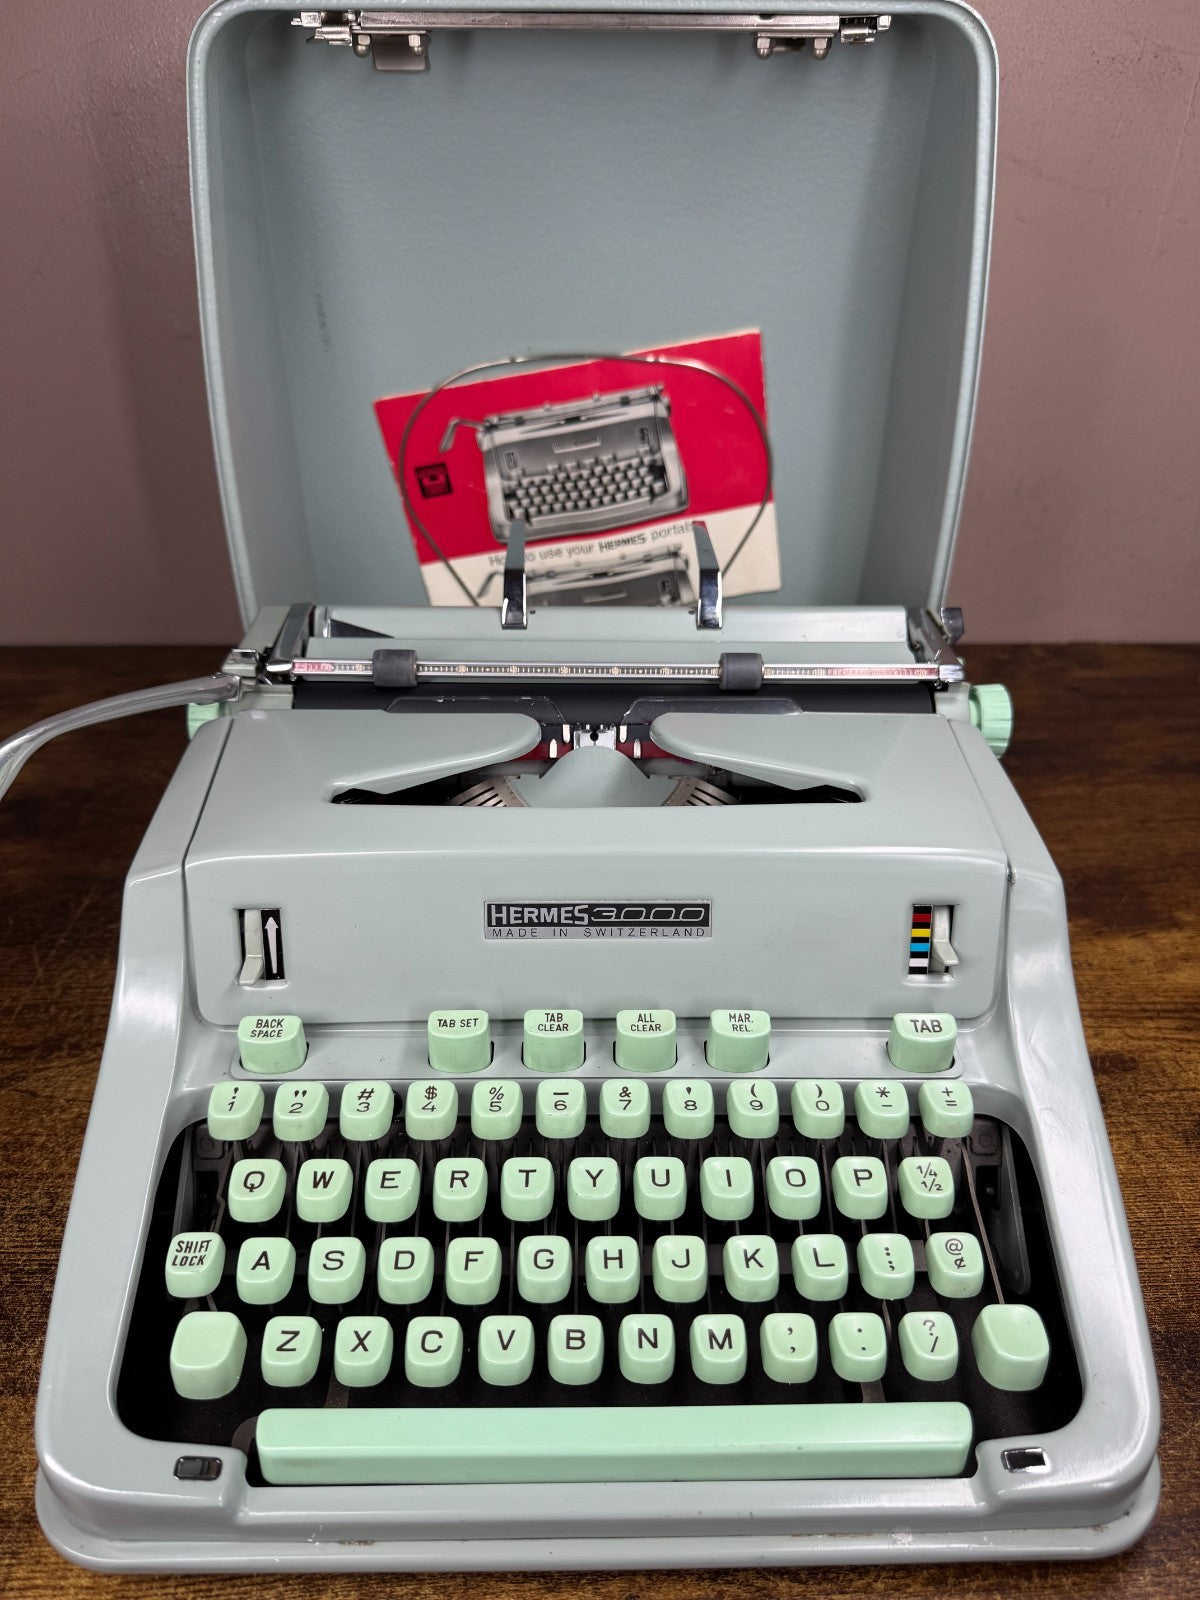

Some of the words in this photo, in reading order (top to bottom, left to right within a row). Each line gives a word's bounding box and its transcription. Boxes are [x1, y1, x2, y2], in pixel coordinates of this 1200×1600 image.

[488, 555, 505, 567] Ho
[538, 548, 562, 560] use
[566, 544, 593, 558] your
[598, 533, 646, 552] HERMES
[491, 904, 588, 925] HERMES
[591, 907, 705, 921] 3000
[492, 928, 537, 937] MADE
[553, 928, 568, 937] IN
[583, 928, 705, 937] SWITZERLAND
[255, 1019, 285, 1029] BACK
[437, 1019, 456, 1028] TAB
[459, 1018, 479, 1028] SET
[544, 1013, 564, 1023] TAB
[637, 1013, 656, 1023] ALL
[728, 1013, 754, 1023] MAR.
[249, 1030, 284, 1038] SPACE
[537, 1024, 569, 1032] CLEAR
[630, 1024, 662, 1032] CLEAR
[731, 1024, 754, 1033] REL.
[910, 1020, 942, 1033] TAB
[358, 1088, 375, 1100] #
[425, 1086, 437, 1099] $
[489, 1086, 504, 1100] %
[618, 1086, 632, 1098] &
[941, 1086, 954, 1097] +
[227, 1100, 235, 1112] 1
[288, 1102, 304, 1114] 2
[356, 1101, 371, 1113] 3
[422, 1101, 436, 1112] 4
[489, 1101, 501, 1112] 5
[553, 1099, 568, 1111] 6
[620, 1099, 632, 1111] 7
[684, 1099, 698, 1111] 8
[749, 1099, 764, 1111] 9
[816, 1100, 829, 1111] 0
[243, 1171, 265, 1192] Q
[313, 1171, 334, 1188] W
[380, 1171, 401, 1188] E
[450, 1170, 469, 1188] R
[519, 1169, 536, 1187] T
[585, 1169, 603, 1187] Y
[651, 1169, 670, 1187] U
[725, 1168, 733, 1188] I
[786, 1169, 806, 1187] O
[854, 1169, 872, 1186] P
[176, 1240, 212, 1253] SHIFT
[945, 1238, 963, 1254] @
[172, 1255, 206, 1266] LOCK
[251, 1251, 270, 1270] A
[323, 1251, 344, 1270] S
[394, 1251, 415, 1270] D
[464, 1251, 483, 1270] F
[534, 1249, 554, 1269] G
[604, 1249, 623, 1269] H
[672, 1249, 690, 1268] J
[744, 1248, 764, 1268] K
[813, 1248, 835, 1267] L
[276, 1330, 300, 1351] Z
[351, 1331, 371, 1352] X
[421, 1330, 443, 1353] C
[497, 1330, 515, 1350] V
[566, 1329, 585, 1350] B
[638, 1328, 658, 1348] N
[709, 1329, 732, 1350] M
